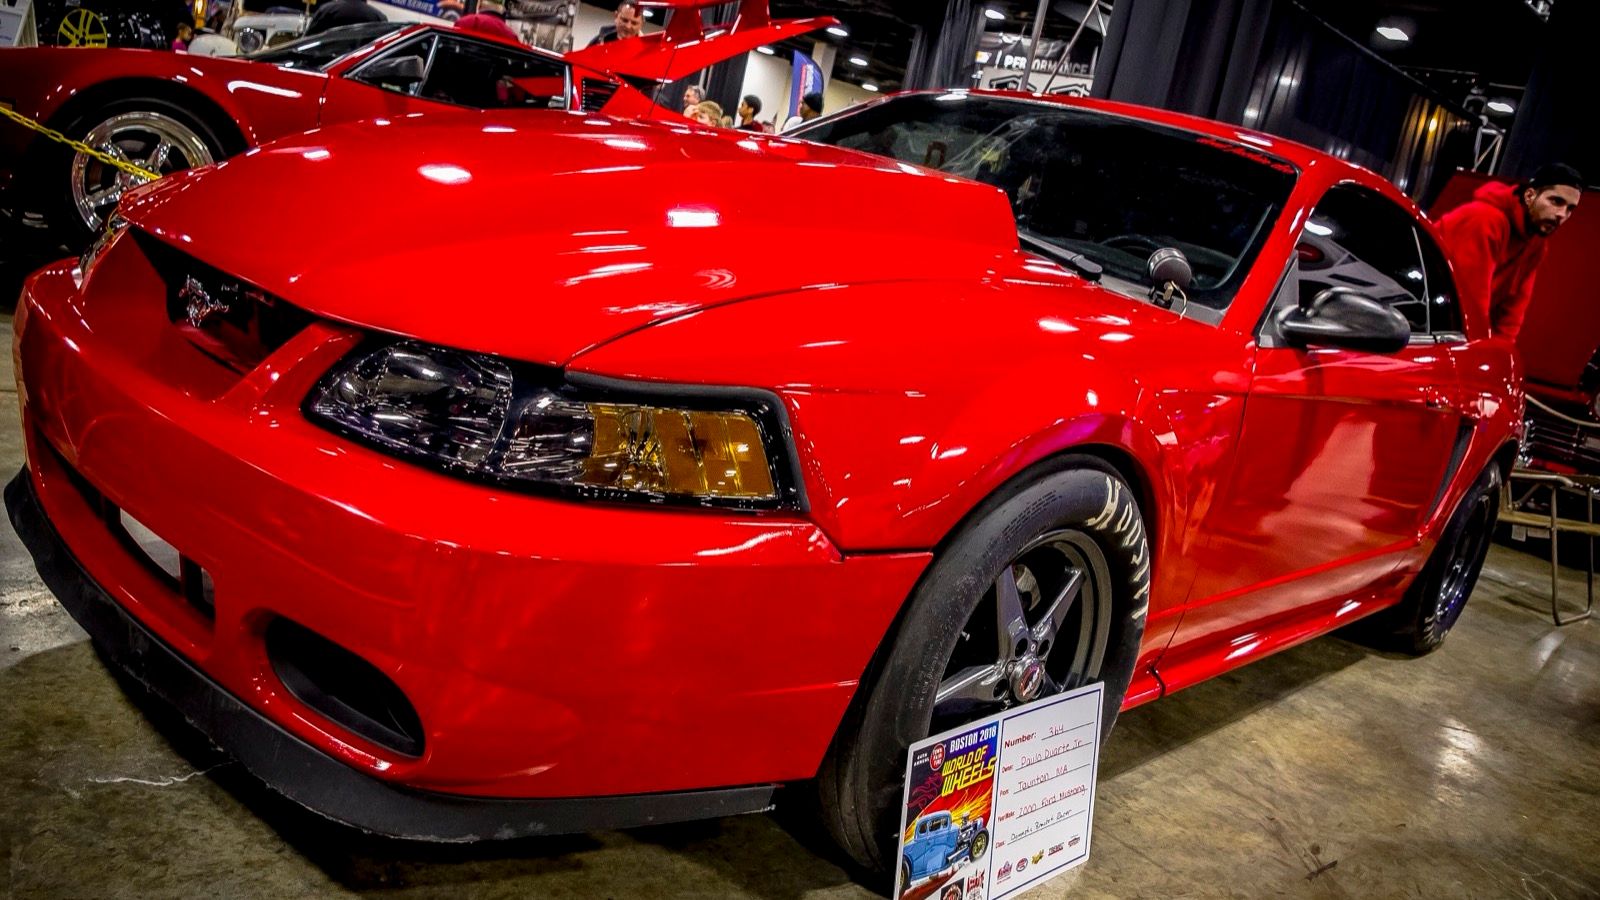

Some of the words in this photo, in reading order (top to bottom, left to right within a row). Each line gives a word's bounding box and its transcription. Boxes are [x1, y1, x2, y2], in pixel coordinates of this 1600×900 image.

[1003, 54, 1089, 75] PERORMANCE
[950, 732, 979, 753] BOSTON
[979, 725, 997, 742] 2018
[1004, 731, 1037, 749] Number:
[942, 751, 975, 777] WORLD
[974, 745, 988, 763] OF
[941, 756, 997, 797] WHEELS
